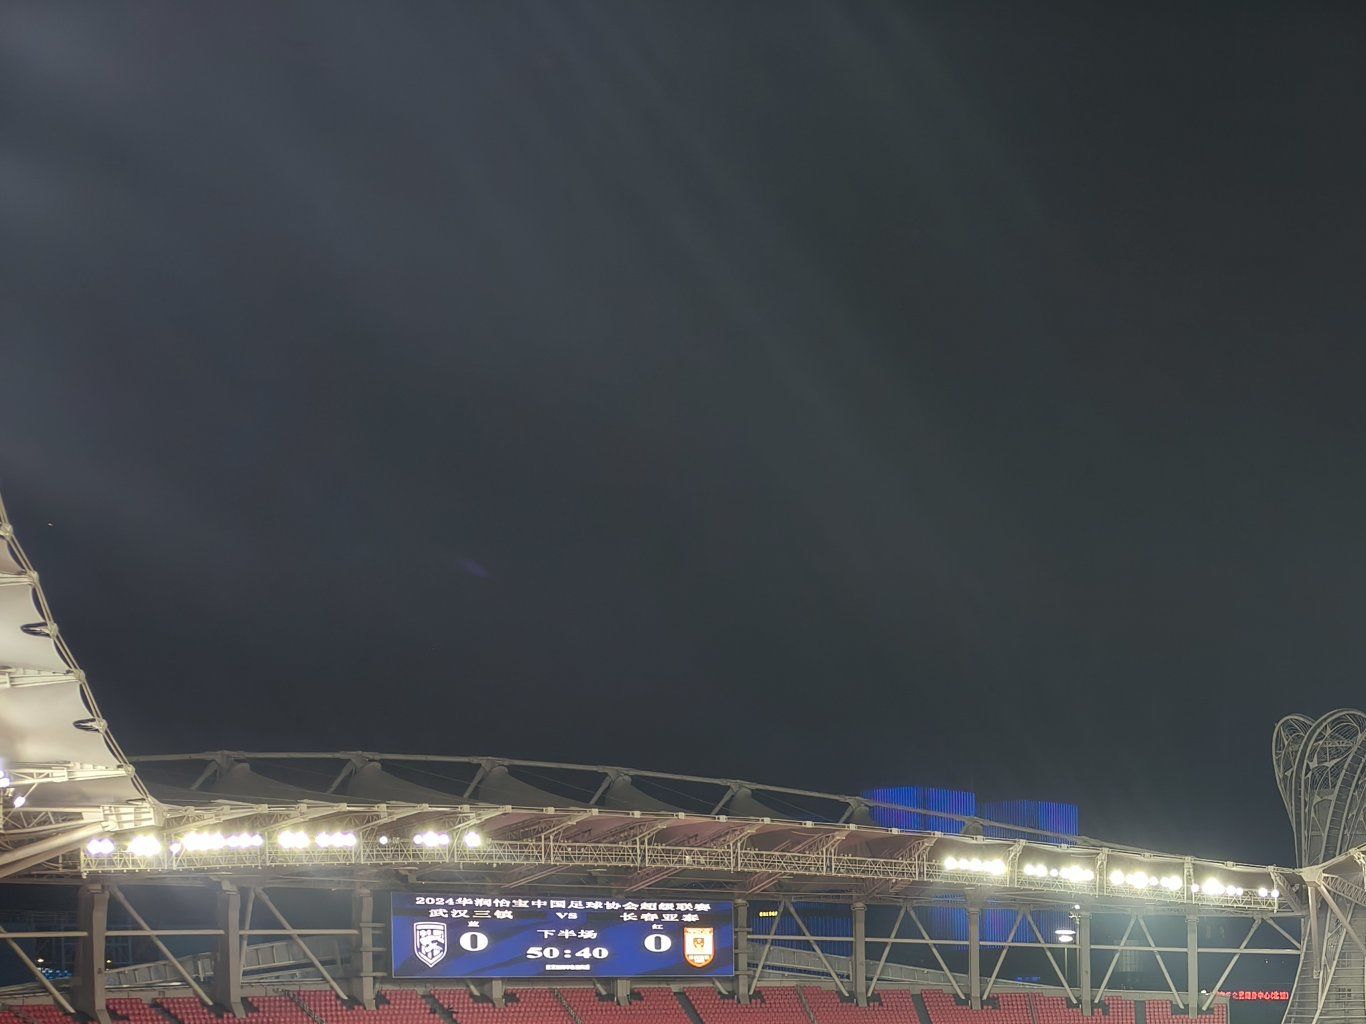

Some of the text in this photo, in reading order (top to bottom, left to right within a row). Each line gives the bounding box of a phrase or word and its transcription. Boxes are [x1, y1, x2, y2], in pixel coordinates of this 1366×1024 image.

[429, 908, 513, 919] 武汉三镇
[556, 912, 578, 920] VS
[620, 912, 699, 922] 长春亚泰
[536, 929, 597, 939] 下半场
[459, 931, 489, 951] 0
[644, 933, 672, 952] 0
[526, 947, 609, 959] 50:40
